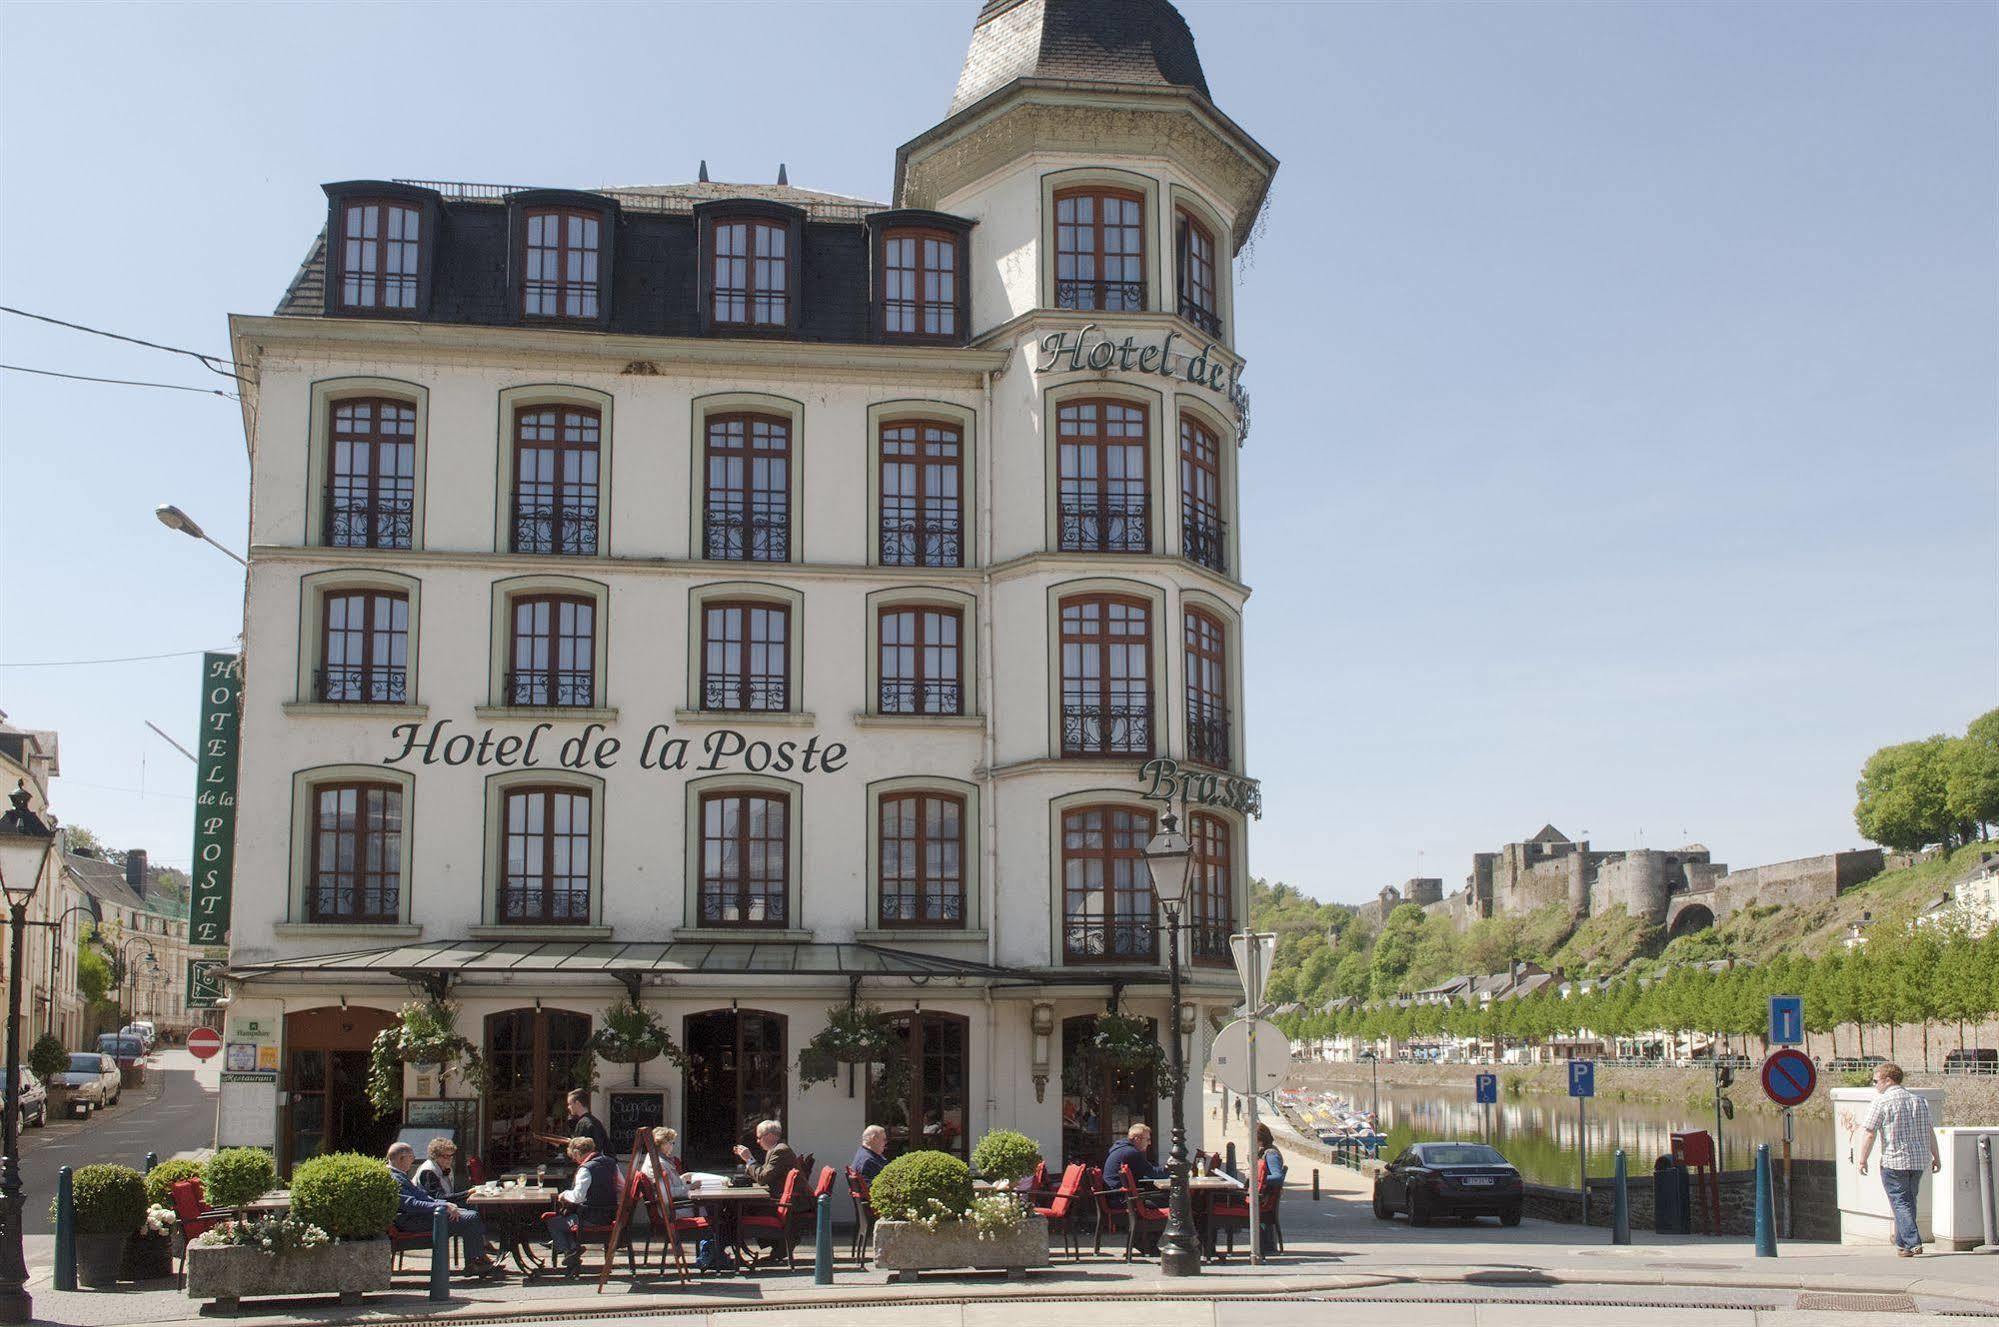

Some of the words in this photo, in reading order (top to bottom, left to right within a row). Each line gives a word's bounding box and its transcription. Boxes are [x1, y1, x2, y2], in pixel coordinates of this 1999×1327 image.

[1034, 323, 1181, 376] Hotel
[1187, 343, 1225, 392] de
[206, 661, 236, 783] HOTEL
[383, 719, 553, 768] Hotel
[560, 723, 621, 769] de
[640, 724, 690, 771] la
[696, 729, 849, 773] Poste
[198, 790, 216, 805] de
[219, 791, 235, 806] la
[197, 817, 223, 941] POSTE
[222, 1072, 273, 1083] Restaurant
[1480, 1076, 1492, 1092] P
[1574, 1064, 1588, 1083] P
